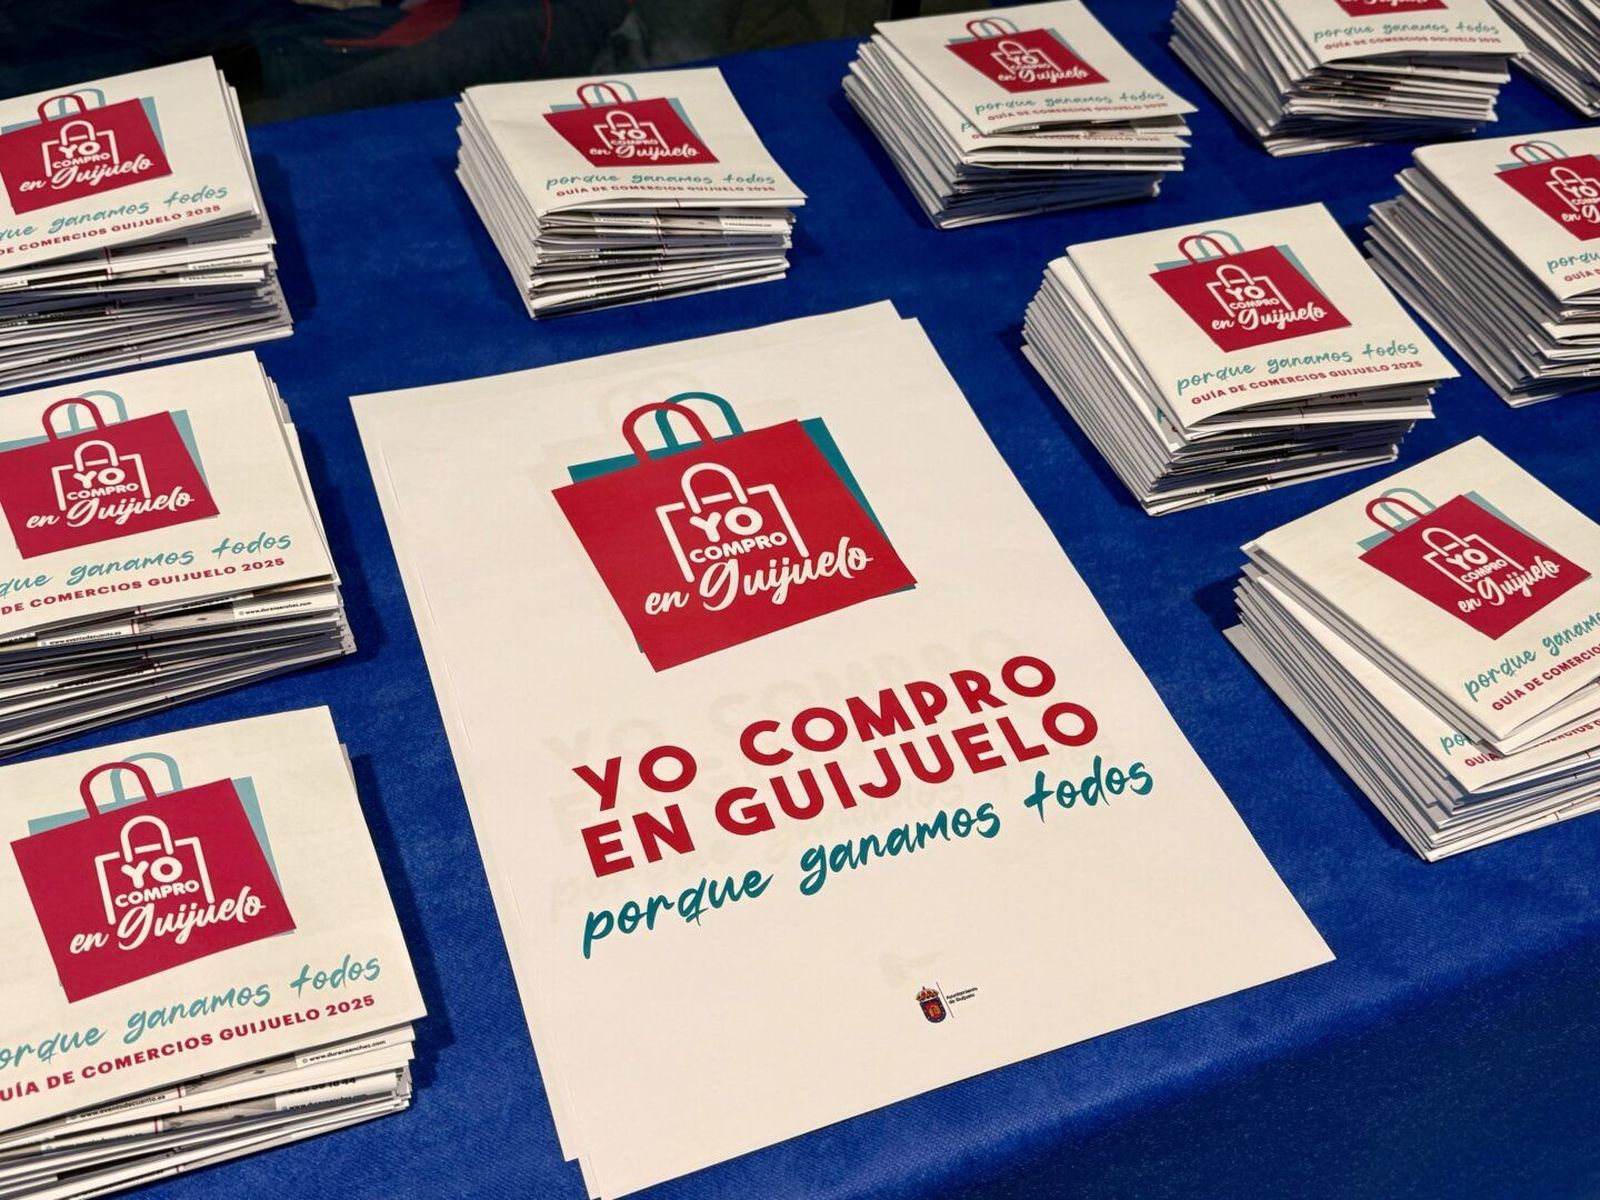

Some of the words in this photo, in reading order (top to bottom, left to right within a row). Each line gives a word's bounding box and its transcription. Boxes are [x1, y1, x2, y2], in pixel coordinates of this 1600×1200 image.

[610, 129, 647, 140] YO
[52, 152, 110, 169] COMPRO
[58, 141, 101, 159] YO
[19, 178, 46, 192] en
[547, 173, 620, 191] porque
[632, 173, 712, 185] ganamos
[723, 173, 775, 184] todos
[1563, 185, 1598, 198] YO
[48, 201, 150, 234] ganamos
[163, 185, 228, 208] todos
[19, 227, 107, 251] COMERCIOS
[112, 212, 182, 233] GUIJUELO
[185, 205, 221, 218] 2025
[1225, 285, 1266, 301] YO
[1229, 297, 1280, 310] COMPRO
[1211, 319, 1235, 330] en
[1177, 363, 1256, 396] porque
[1267, 350, 1353, 374] ganamos
[1362, 340, 1420, 360] todos
[1191, 388, 1227, 405] GUÍA
[1228, 383, 1246, 394] DE
[1249, 371, 1327, 390] COMERCIOS
[1328, 365, 1390, 378] GUIJUELO
[66, 482, 139, 500] COMPRO
[73, 467, 125, 489] YO
[26, 513, 60, 529] en
[689, 505, 763, 542] YO
[66, 550, 194, 586] ganamos
[211, 531, 292, 559] todos
[689, 531, 788, 564] COMPRO
[1446, 548, 1489, 571] YO
[1460, 559, 1508, 583] COMPRO
[1, 602, 24, 616] DE
[30, 580, 142, 608] COMERCIOS
[148, 565, 236, 586] GUIJUELO
[242, 557, 285, 572] 2025
[644, 587, 689, 615] en
[1458, 598, 1482, 613] en
[1464, 650, 1536, 702] porque
[1492, 689, 1526, 711] GUÍA
[1524, 678, 1544, 692] DE
[572, 744, 697, 811] YO
[739, 655, 1056, 766] COMPRO
[580, 804, 696, 878] EN
[715, 702, 1099, 836] GUIJUELO
[582, 872, 773, 959] porque
[800, 802, 1001, 896] ganamos
[1023, 755, 1154, 823] todos
[120, 856, 183, 889] YO
[115, 880, 200, 907] COMPRO
[70, 931, 109, 954] en
[122, 984, 271, 1045] ganamos
[290, 954, 381, 999] todos
[46, 1070, 75, 1089] DE
[82, 1033, 213, 1078] COMERCIOS
[219, 1009, 320, 1041] GUIJUELO
[326, 995, 375, 1017] 2025
